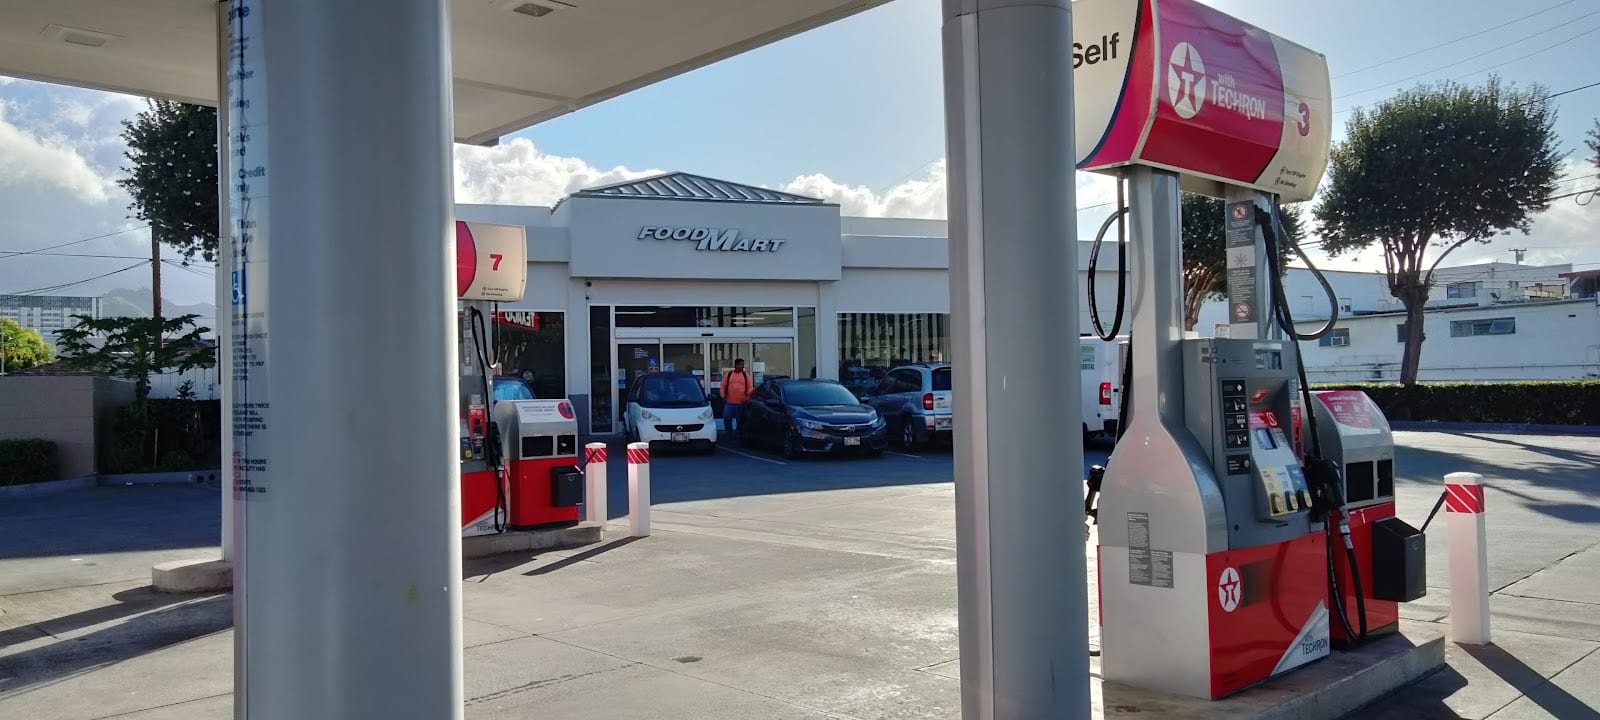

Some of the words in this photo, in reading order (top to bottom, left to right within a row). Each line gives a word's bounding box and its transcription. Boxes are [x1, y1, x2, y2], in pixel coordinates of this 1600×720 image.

[1217, 72, 1236, 89] with
[1211, 80, 1266, 120] TECHRON
[1297, 102, 1310, 137] 3
[238, 166, 266, 178] Credit
[490, 253, 503, 271] 7
[1302, 638, 1328, 656] TECHRON
